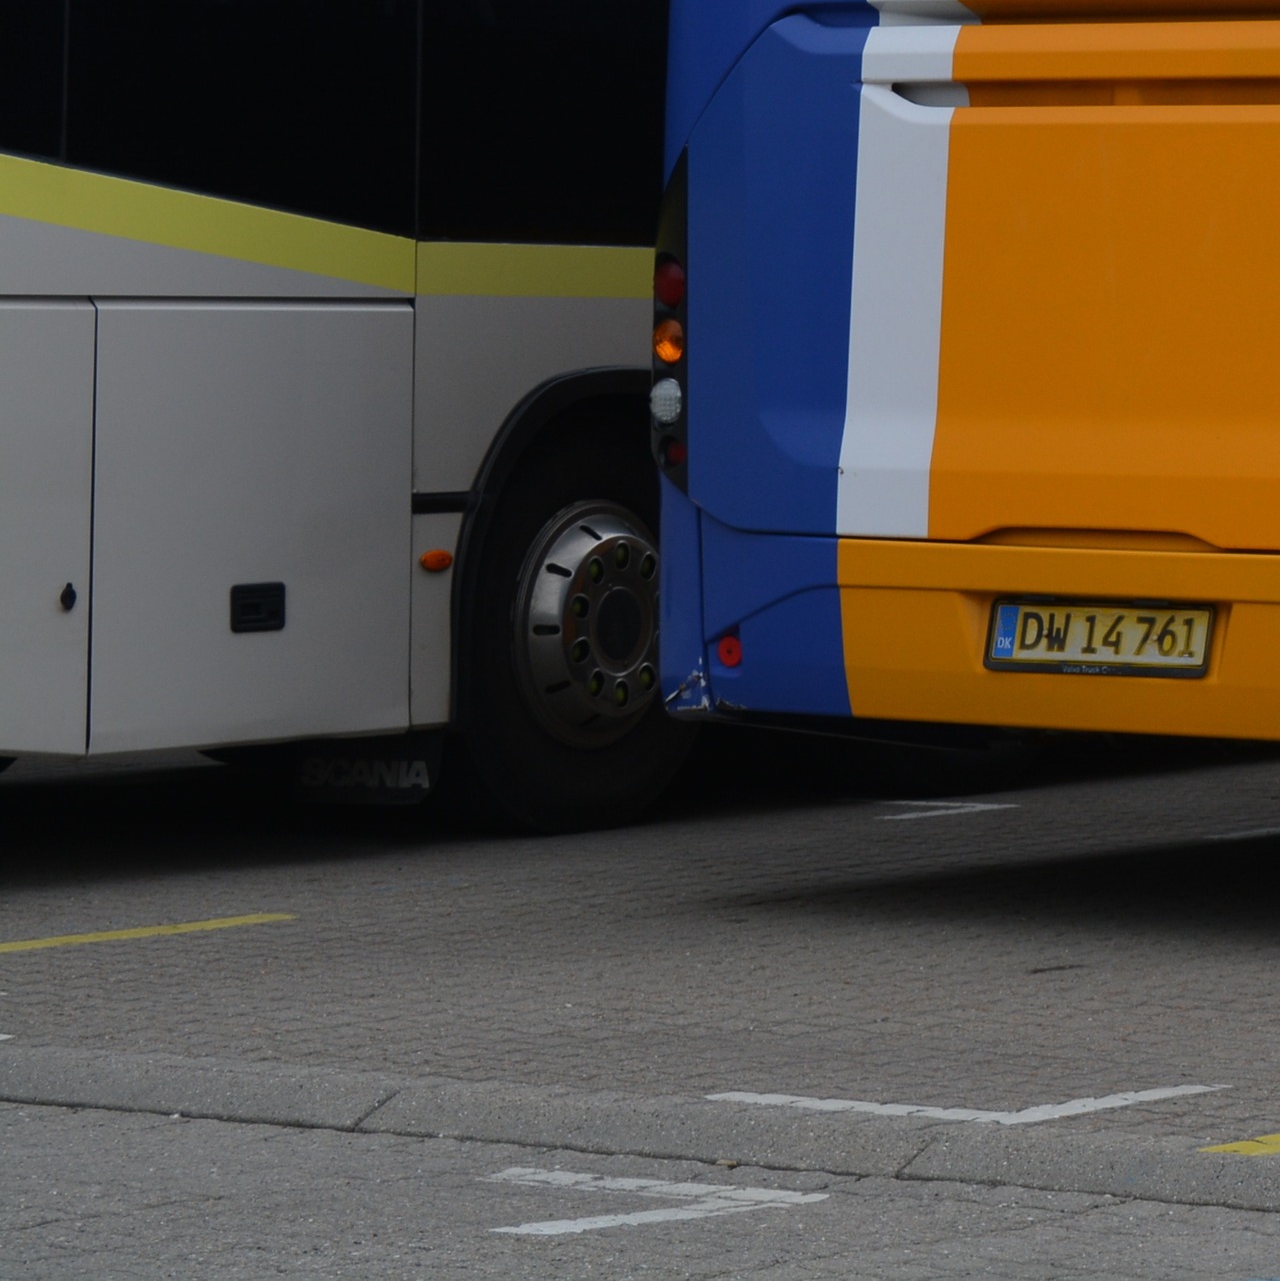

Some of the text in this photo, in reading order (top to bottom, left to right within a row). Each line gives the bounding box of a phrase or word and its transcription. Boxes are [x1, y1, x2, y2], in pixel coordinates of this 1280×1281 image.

[996, 636, 1012, 649] DK
[1019, 611, 1194, 657] DW 14 761
[301, 758, 430, 788] SCANIA
